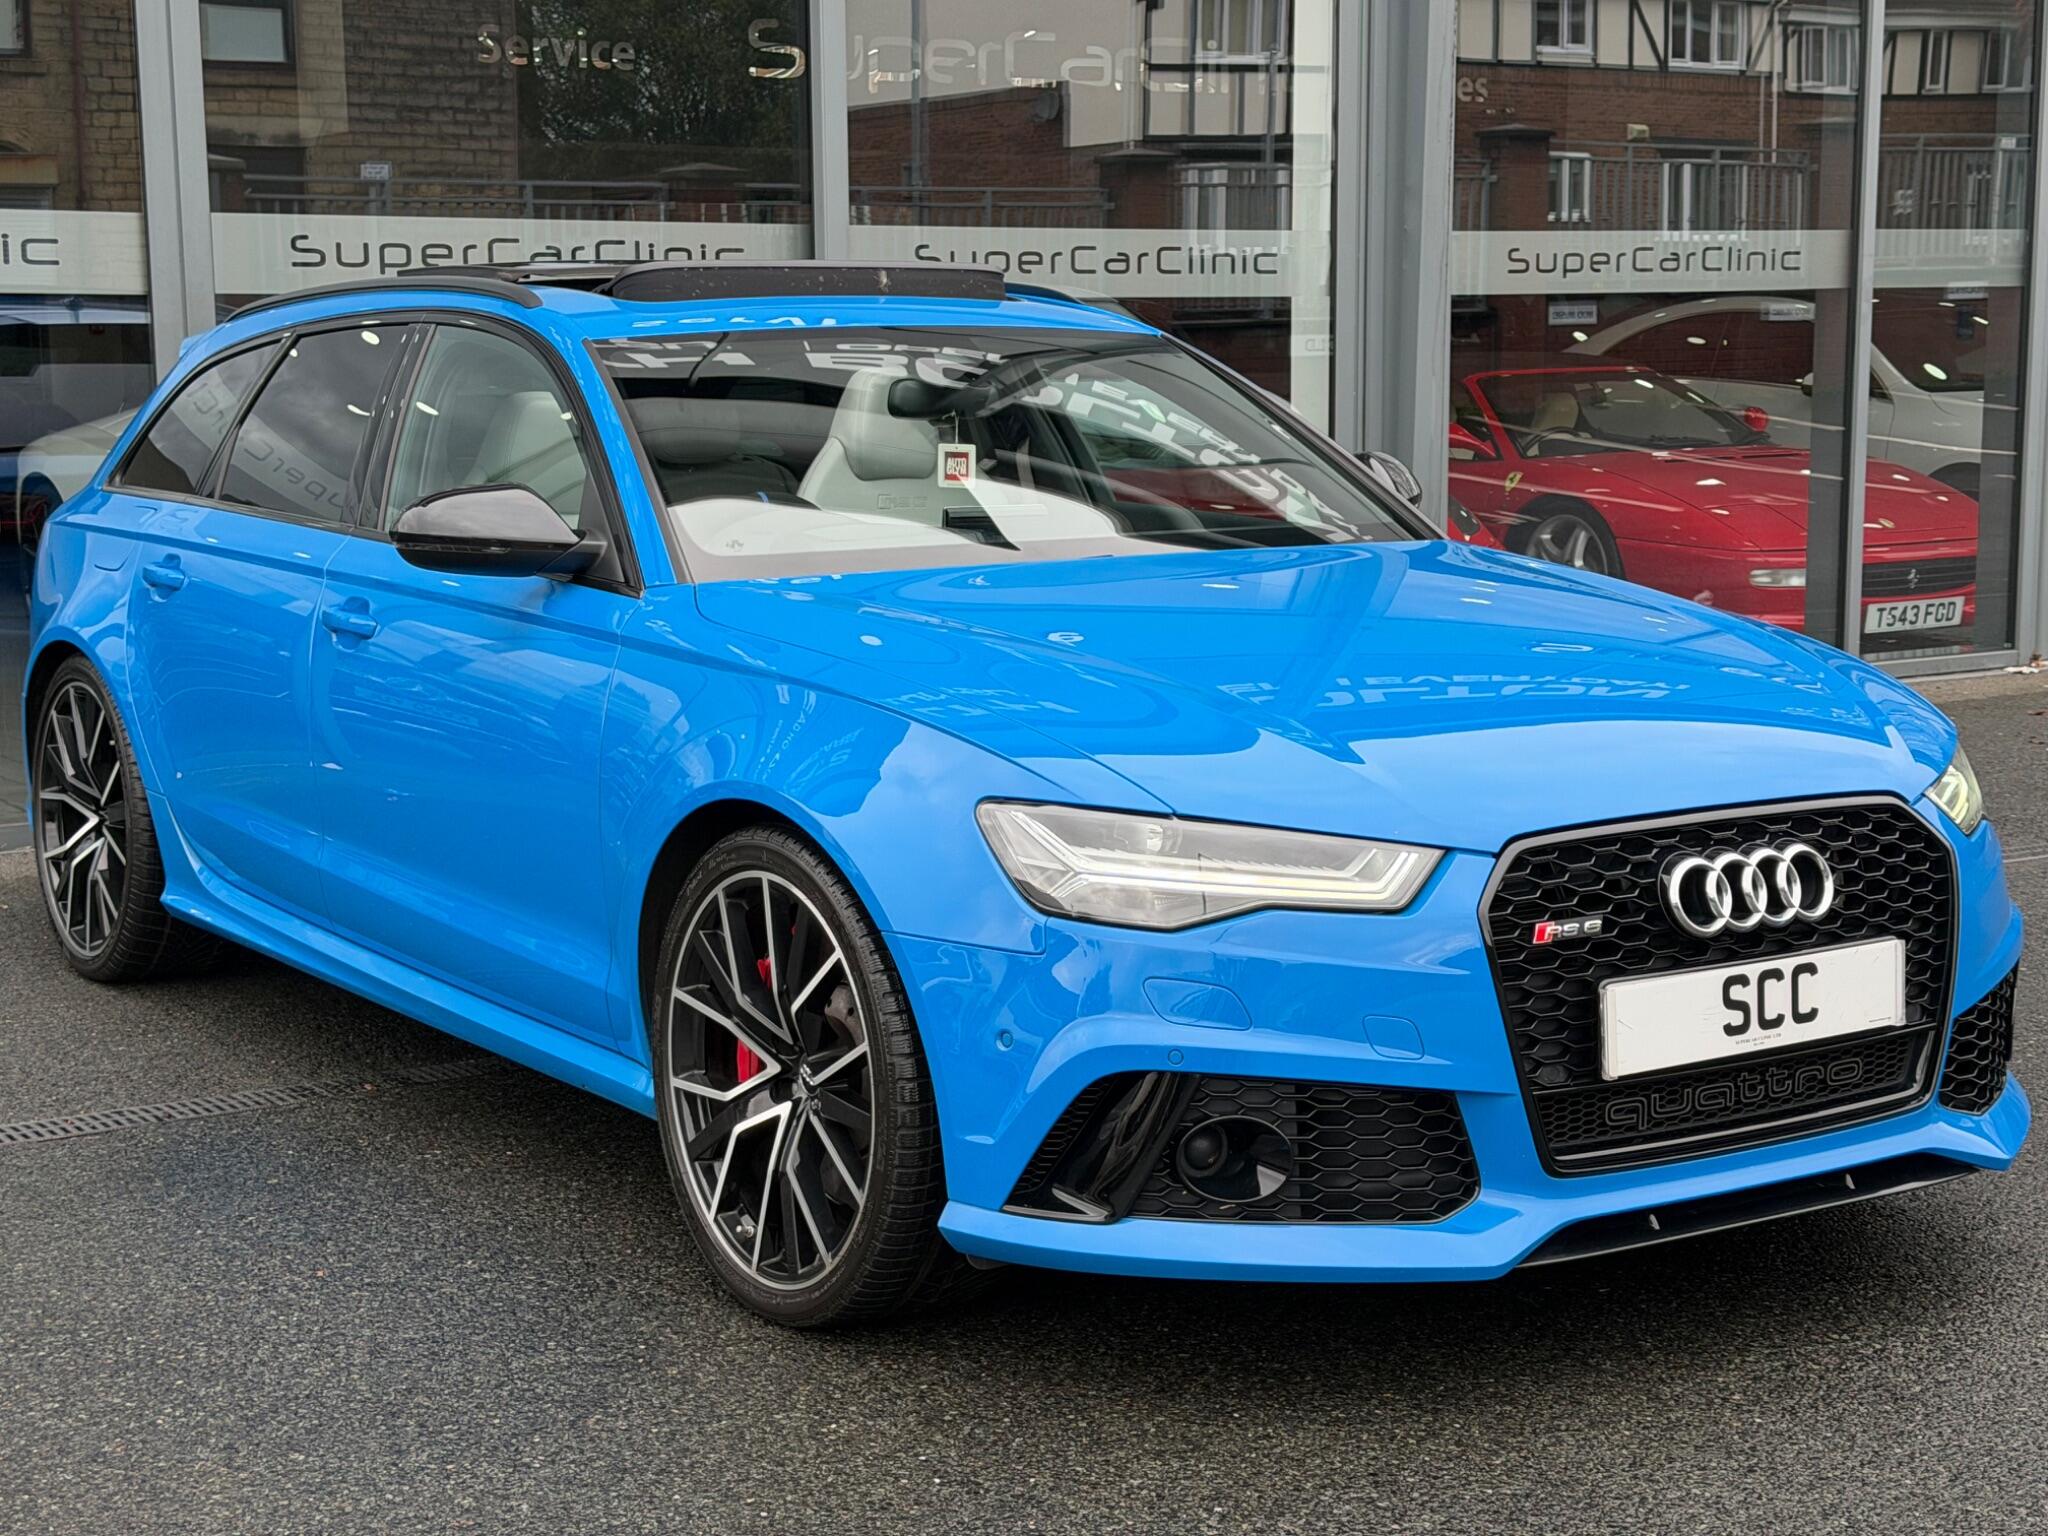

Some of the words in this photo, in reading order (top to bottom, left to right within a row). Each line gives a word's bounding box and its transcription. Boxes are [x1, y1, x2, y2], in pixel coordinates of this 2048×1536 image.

[477, 24, 636, 71] Service
[1507, 246, 1801, 279] SuperCarClinic
[1876, 604, 1920, 628] T543
[1722, 961, 1819, 1037] SCC
[1605, 1058, 1863, 1130] quattro
